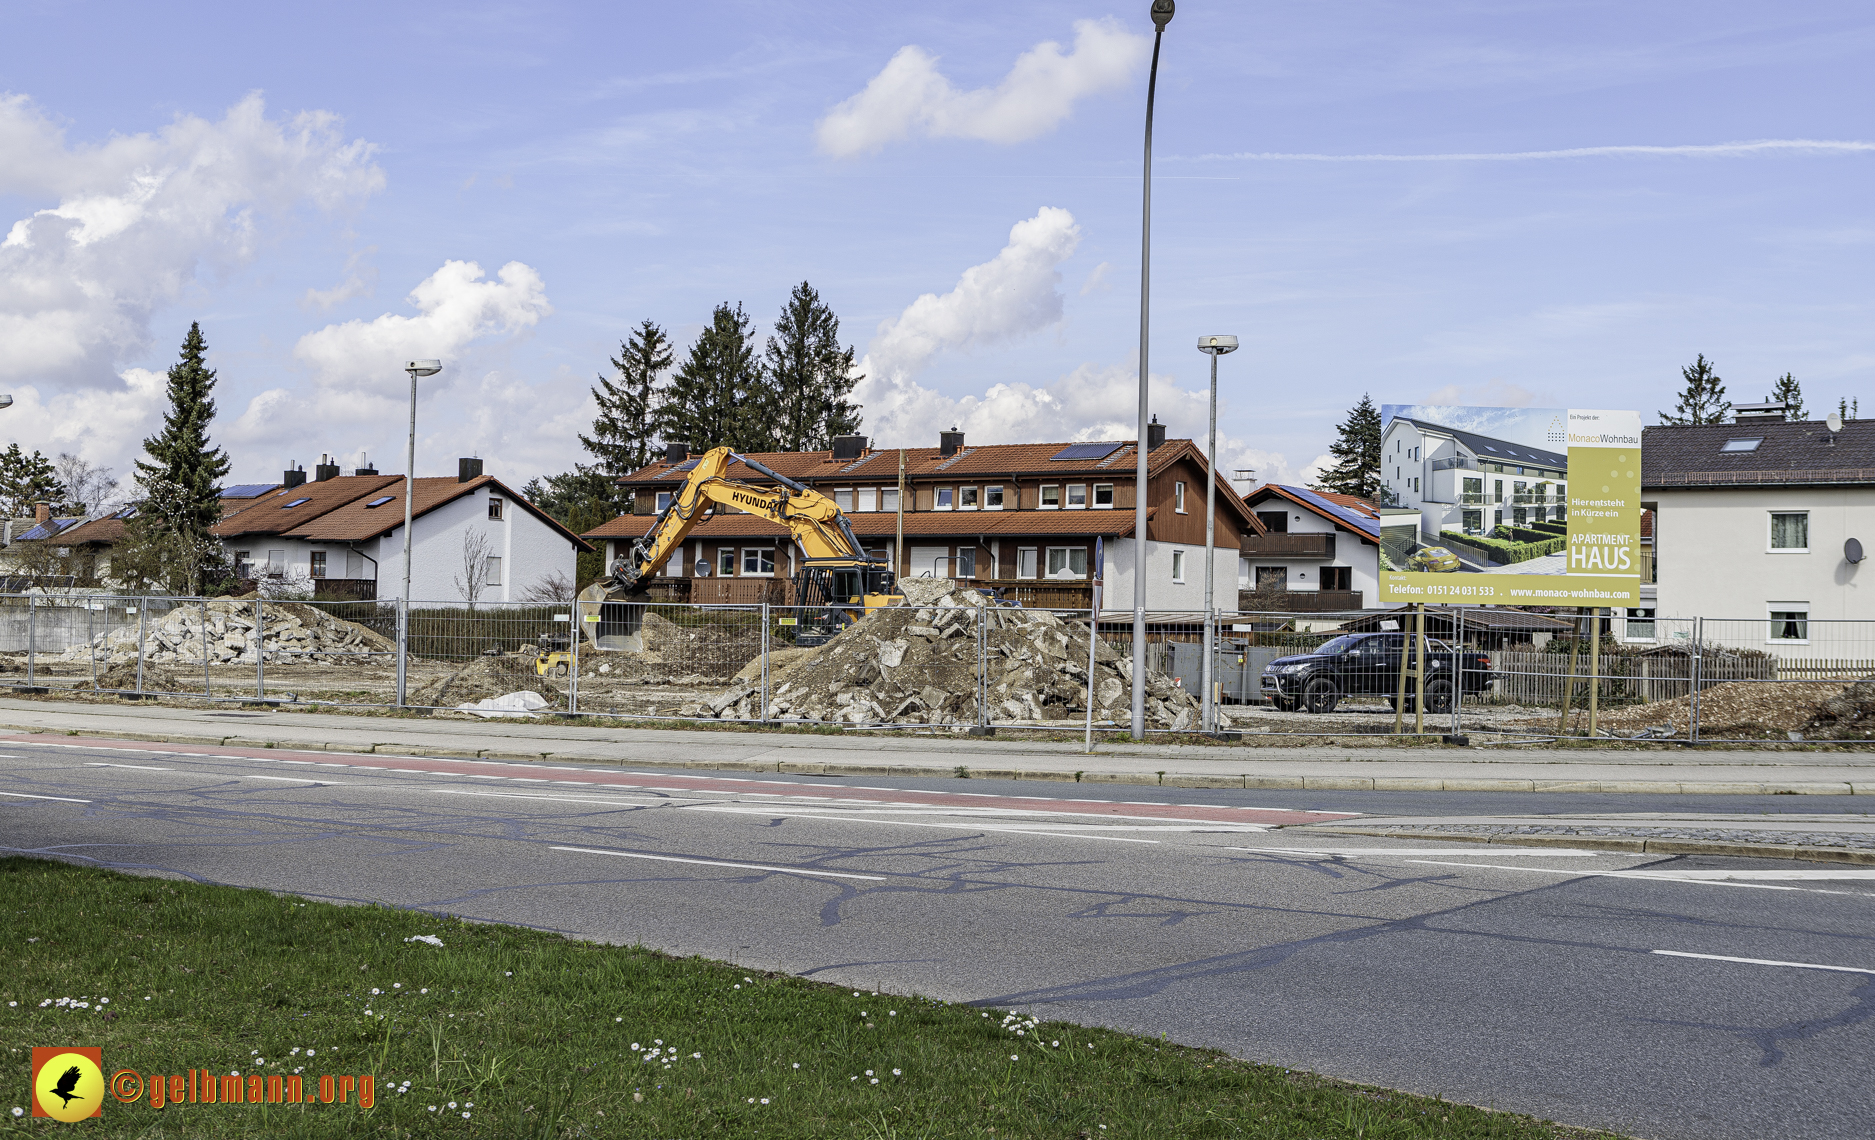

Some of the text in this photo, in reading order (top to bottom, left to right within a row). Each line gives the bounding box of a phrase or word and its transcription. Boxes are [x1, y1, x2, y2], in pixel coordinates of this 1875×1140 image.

[1568, 433, 1639, 444] MonacoWohnbau
[1571, 498, 1625, 507] Hier entsteht
[1571, 509, 1580, 517] in
[1581, 509, 1604, 517] Kürze
[1571, 533, 1633, 545] APARTMENT-
[1571, 546, 1631, 570] HAUS
[1389, 584, 1424, 595] Telefon:
[1427, 585, 1447, 595] 0151
[1449, 586, 1460, 595] 24
[1461, 586, 1477, 595] 031
[1479, 586, 1494, 596] 533
[1510, 588, 1630, 599] www.monaco-wohnbau.com
